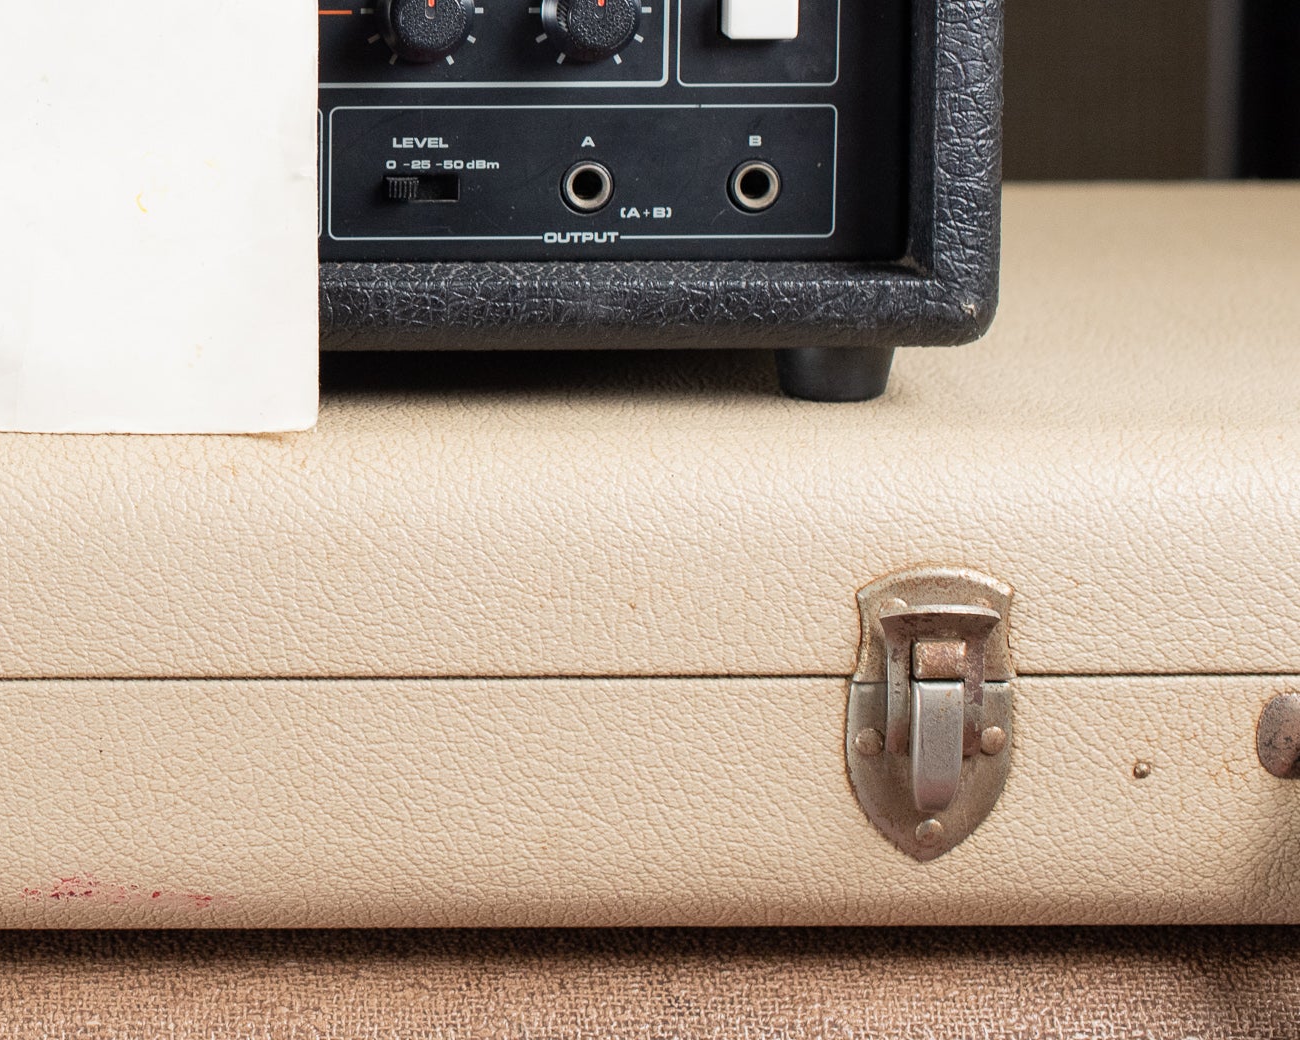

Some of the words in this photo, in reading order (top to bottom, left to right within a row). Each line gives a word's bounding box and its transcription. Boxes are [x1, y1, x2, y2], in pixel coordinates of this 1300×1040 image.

[392, 136, 449, 149] LEVEL
[580, 136, 596, 148] A
[748, 135, 762, 147] B
[385, 159, 397, 170] 0
[403, 159, 431, 170] -25
[465, 159, 500, 170] dBm
[543, 231, 619, 244] OUTPUT
